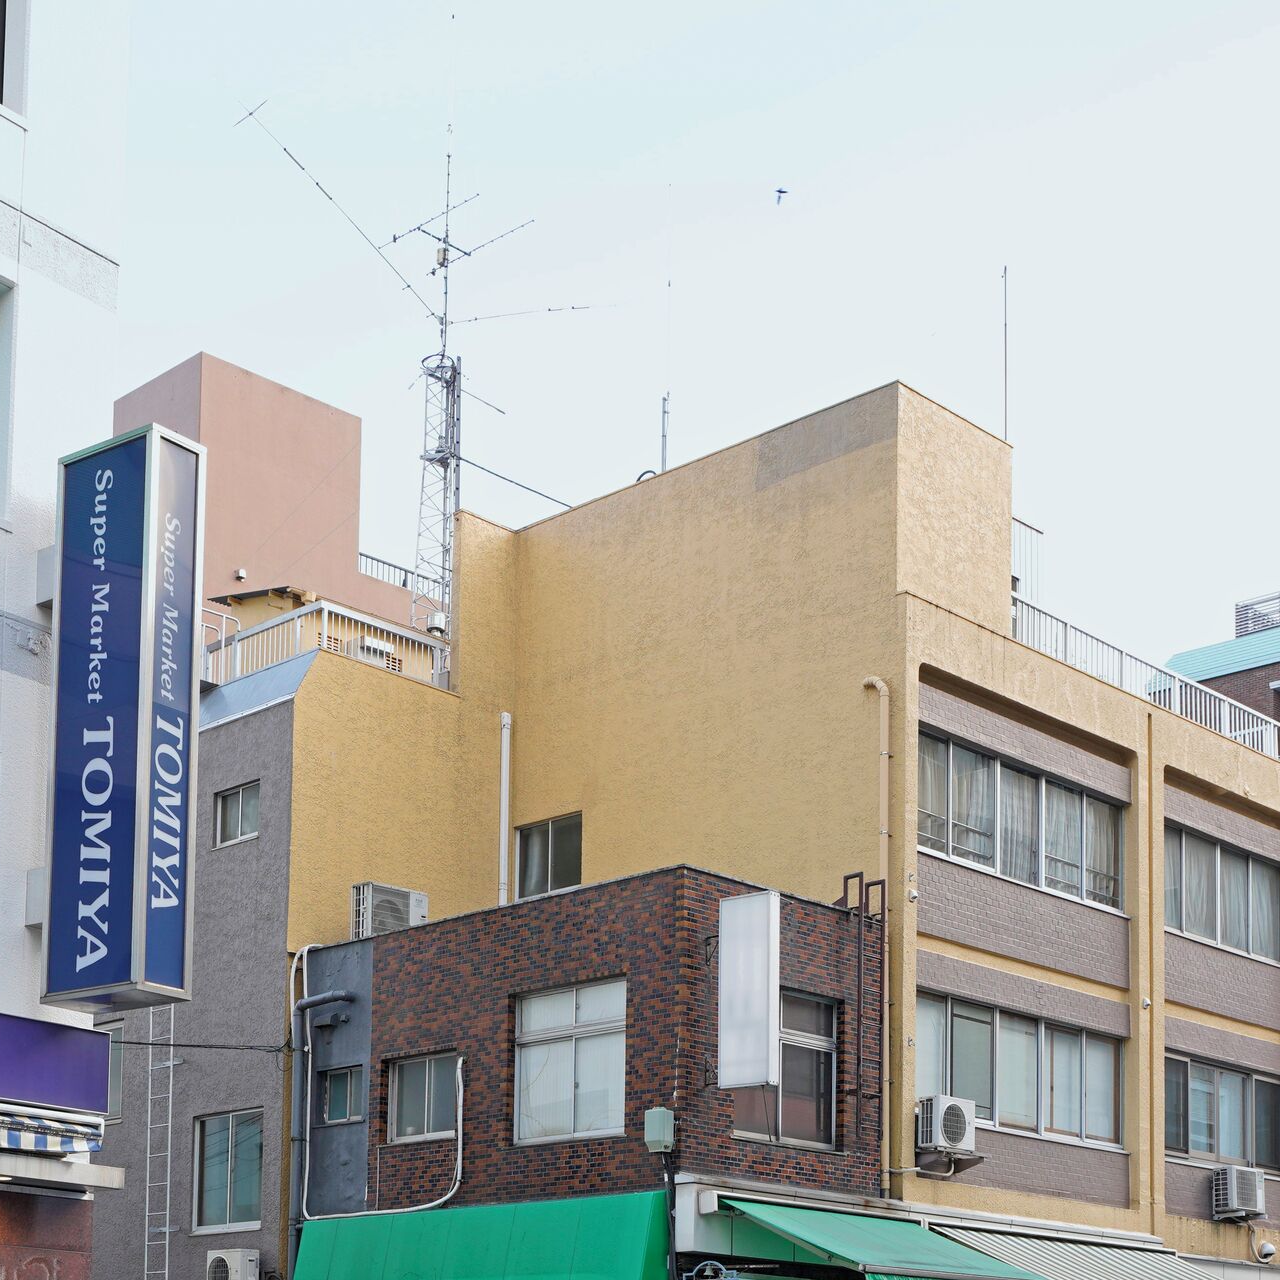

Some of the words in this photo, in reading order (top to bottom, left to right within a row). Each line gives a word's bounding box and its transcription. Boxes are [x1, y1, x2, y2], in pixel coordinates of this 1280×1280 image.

[88, 468, 114, 571] Super
[160, 512, 182, 597] Super
[86, 582, 111, 704] Market
[160, 601, 179, 703] Market
[75, 715, 115, 974] TOMIYA
[151, 714, 184, 910] TOMIYA
